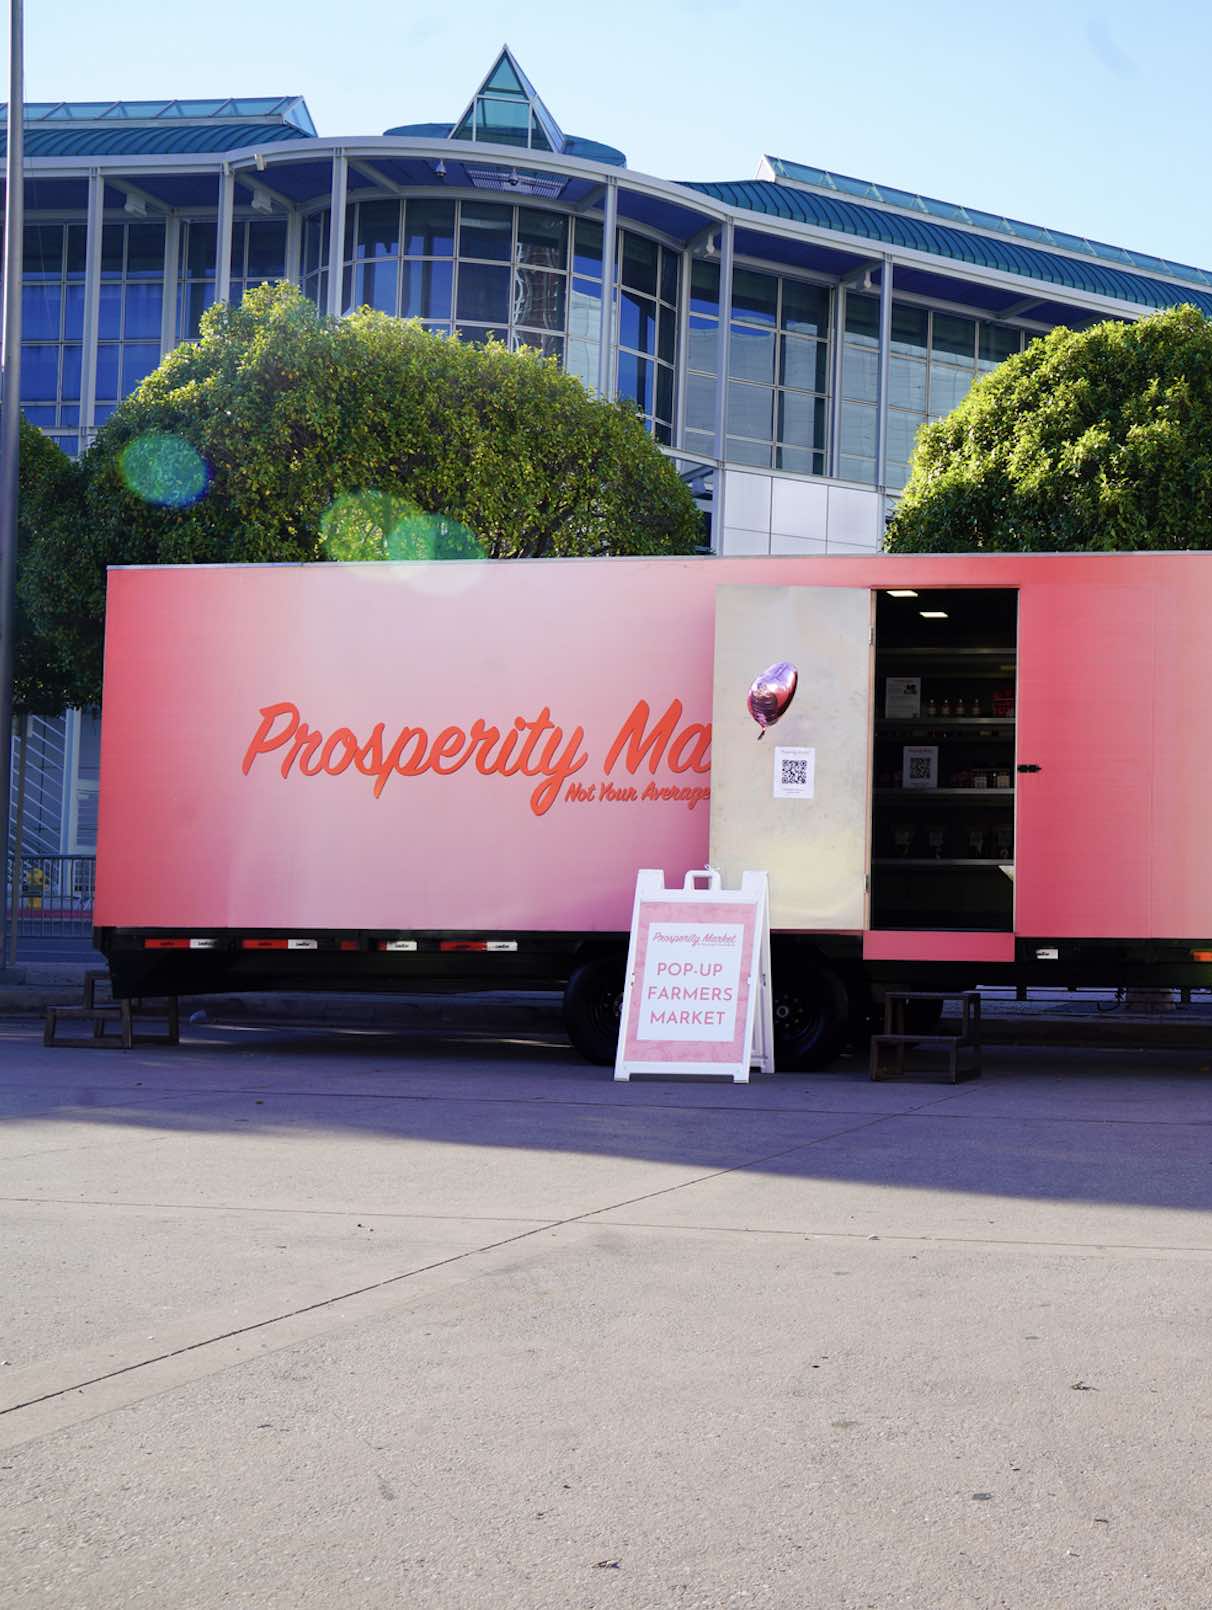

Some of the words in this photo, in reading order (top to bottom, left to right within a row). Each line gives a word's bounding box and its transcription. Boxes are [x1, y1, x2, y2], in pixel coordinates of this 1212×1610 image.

[242, 702, 588, 817] Prosperity
[565, 782, 596, 802] Not
[599, 782, 639, 802] Your
[641, 781, 711, 810] Average
[657, 962, 723, 977] POP-UP
[648, 986, 733, 1001] FARMERS
[650, 1010, 726, 1025] MARKET
